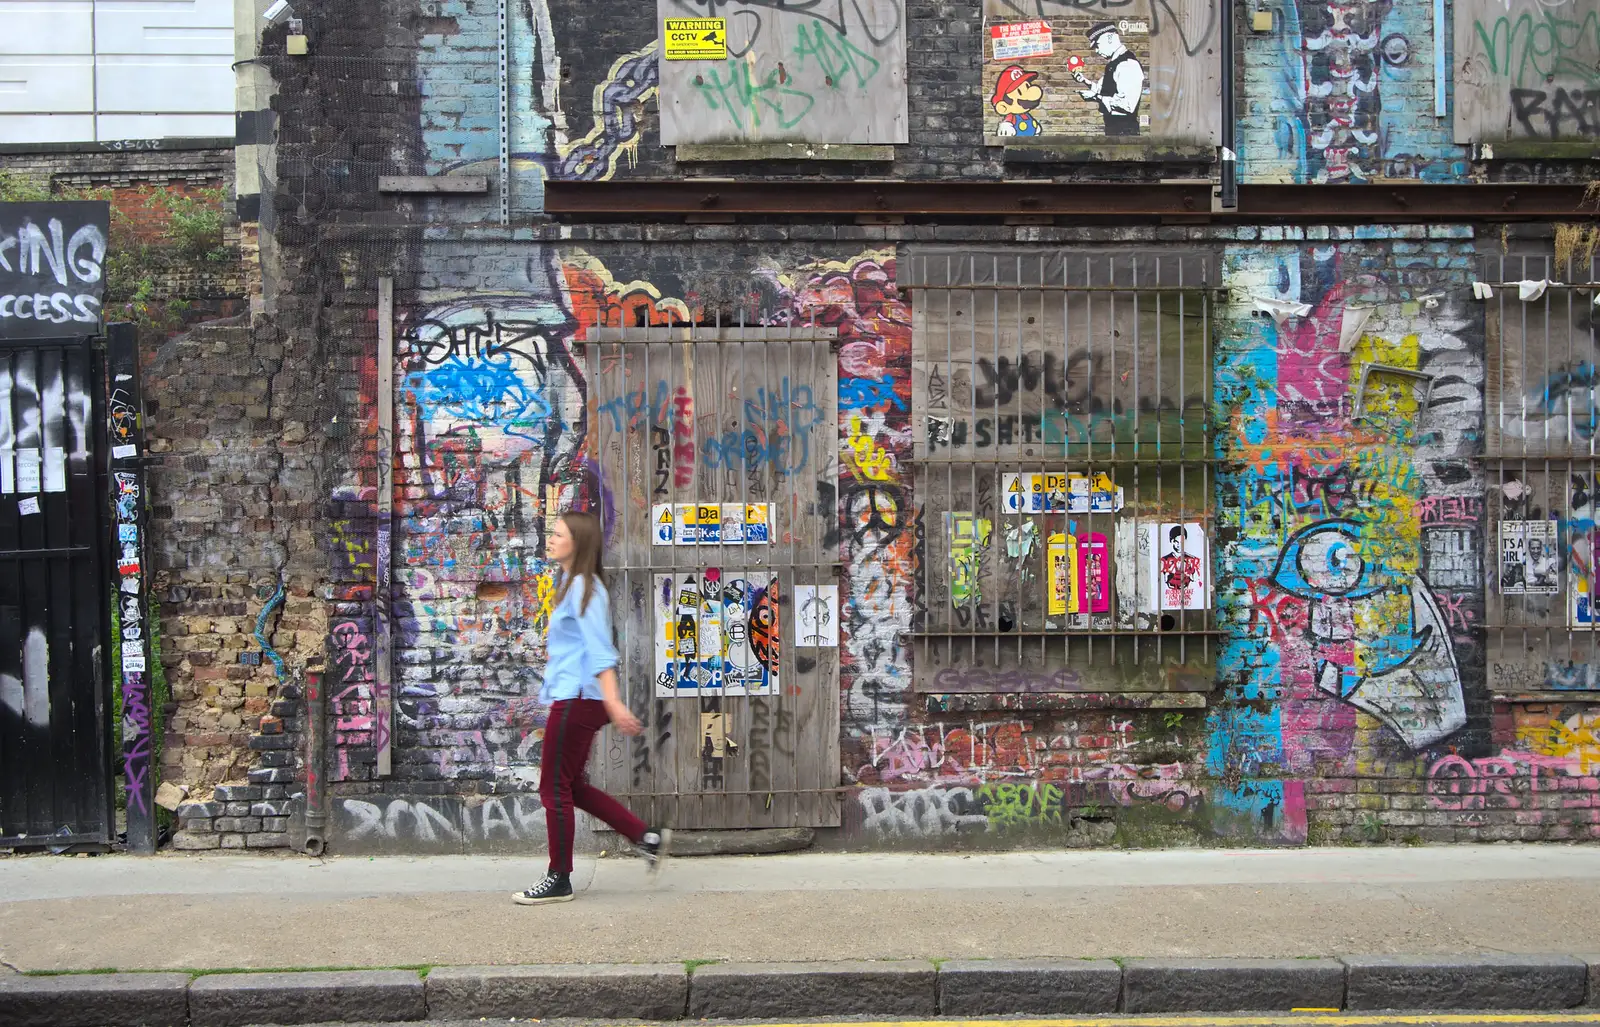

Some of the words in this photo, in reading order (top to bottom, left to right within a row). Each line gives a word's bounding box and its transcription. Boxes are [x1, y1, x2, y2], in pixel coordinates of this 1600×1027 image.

[669, 21, 722, 30] WARNING
[671, 33, 698, 41] CCTV
[1502, 538, 1516, 549] T'S
[1517, 538, 1524, 549] A
[1160, 556, 1200, 577] DEXER
